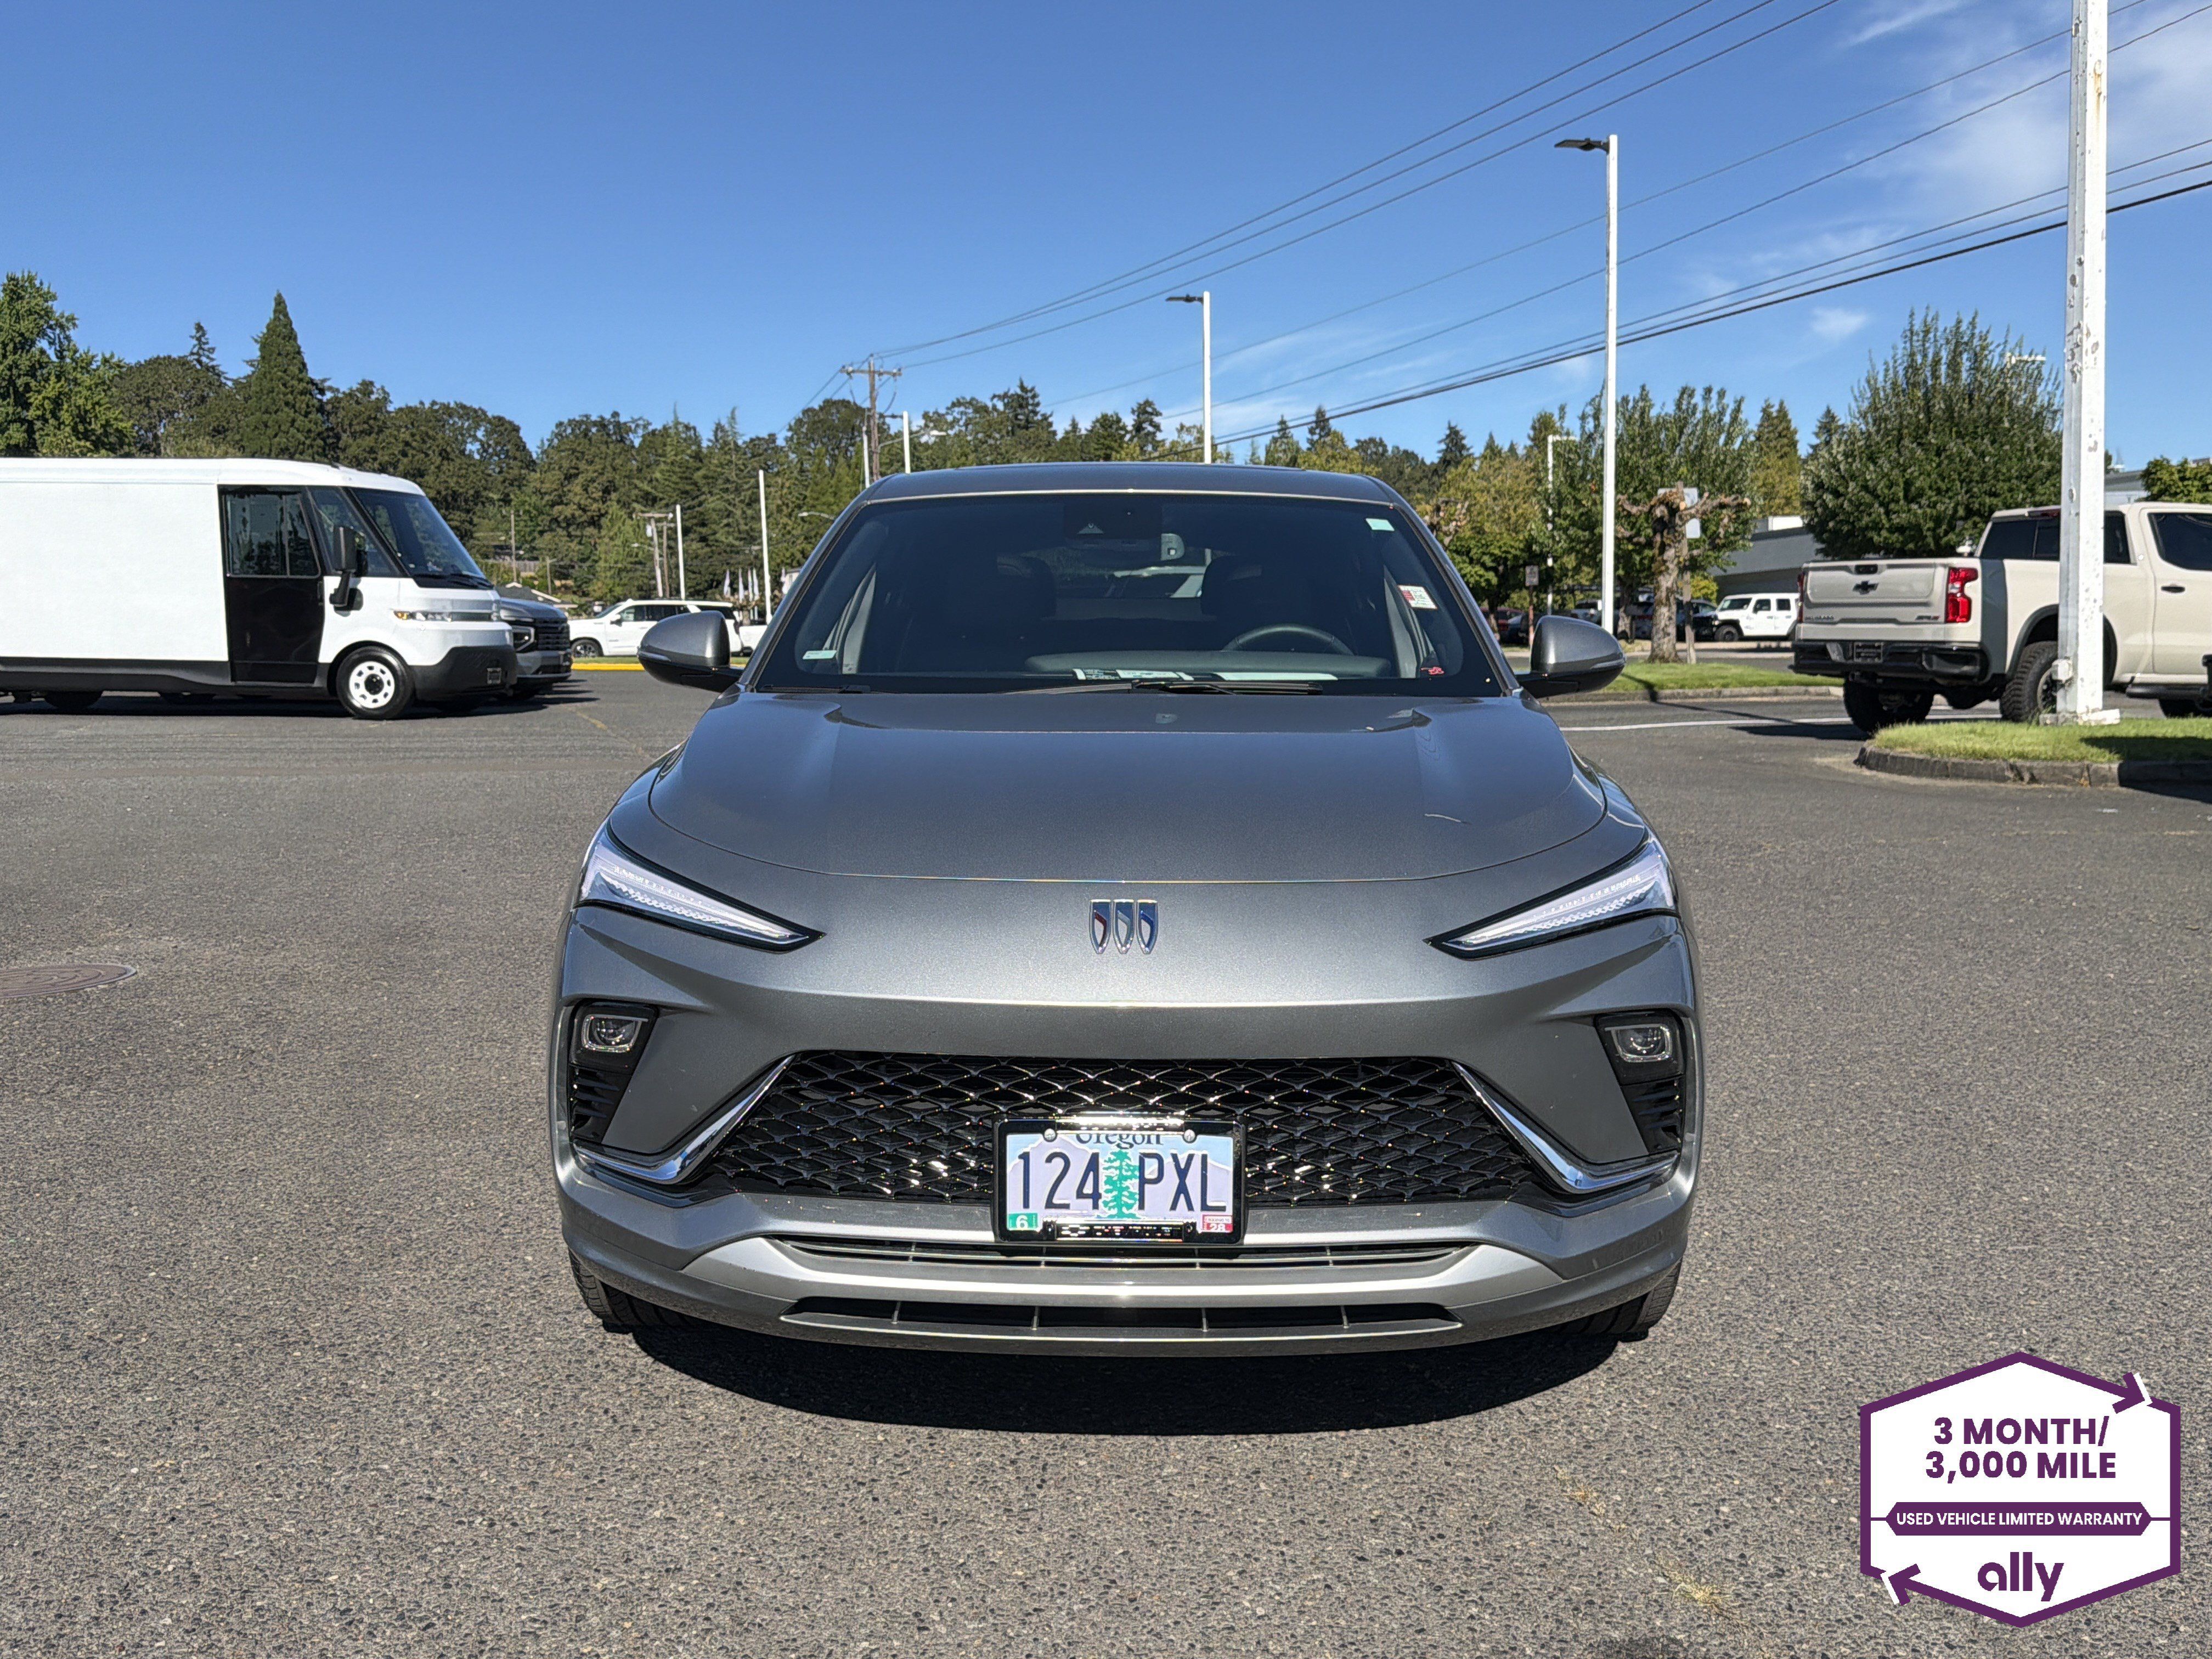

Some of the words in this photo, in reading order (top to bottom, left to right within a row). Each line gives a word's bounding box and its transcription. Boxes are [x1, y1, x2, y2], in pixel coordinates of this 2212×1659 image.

[1076, 1133, 1164, 1149] Oregon
[1018, 1152, 1102, 1210] 124
[1138, 1152, 1227, 1212] PXL
[1016, 1215, 1029, 1231] 6
